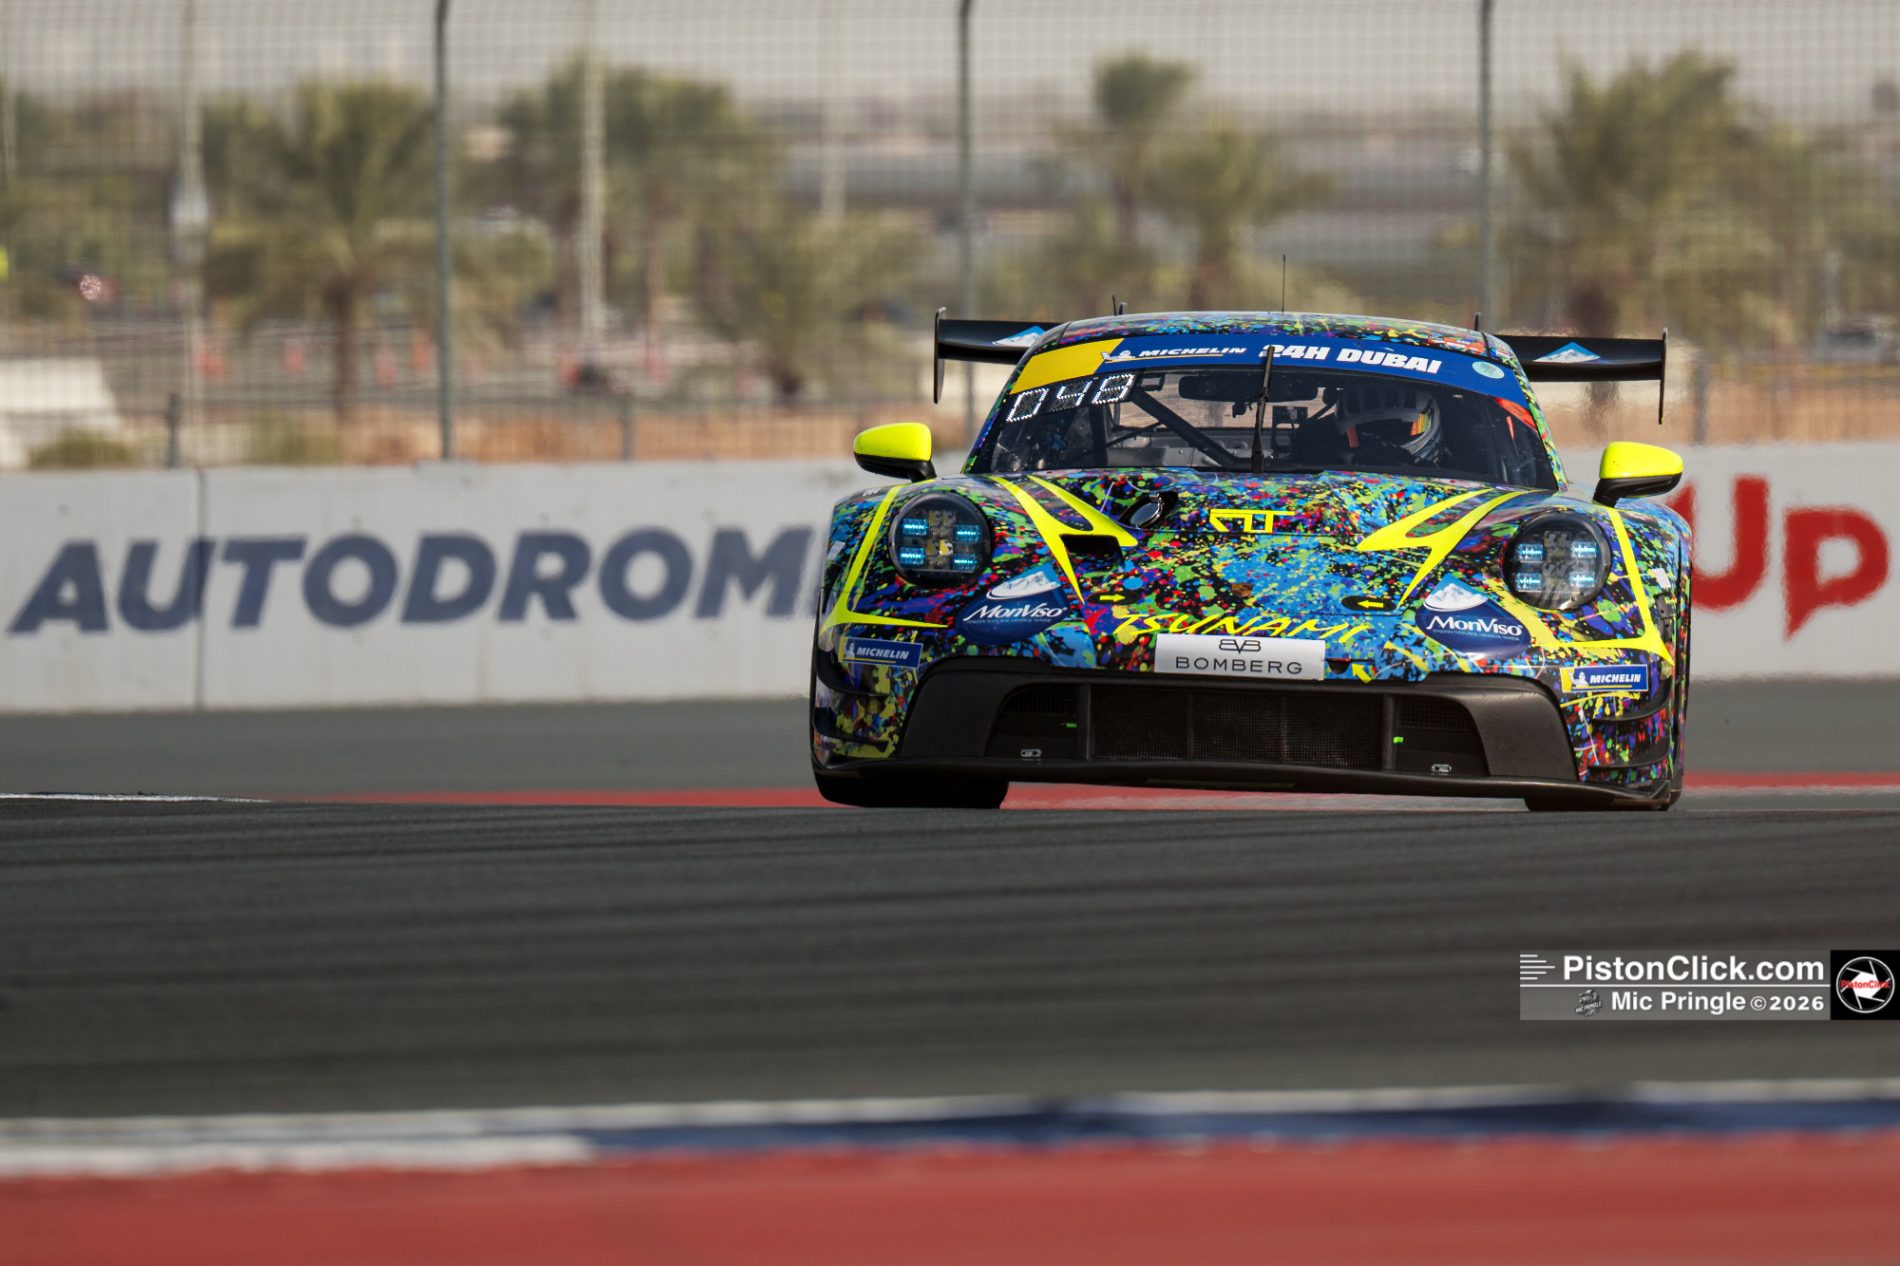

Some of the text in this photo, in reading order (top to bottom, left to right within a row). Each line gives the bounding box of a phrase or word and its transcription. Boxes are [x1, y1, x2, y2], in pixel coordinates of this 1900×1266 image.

[1138, 347, 1247, 357] MICHELIN
[1258, 344, 1442, 374] 24H DUBAI
[1006, 373, 1135, 422] 048
[5, 523, 821, 635] AUTODROM
[1112, 613, 1373, 643] TSUNAMI
[856, 646, 910, 660] MICHELIN
[1175, 656, 1303, 675] BOMBERG
[1589, 673, 1642, 684] MICHELIN
